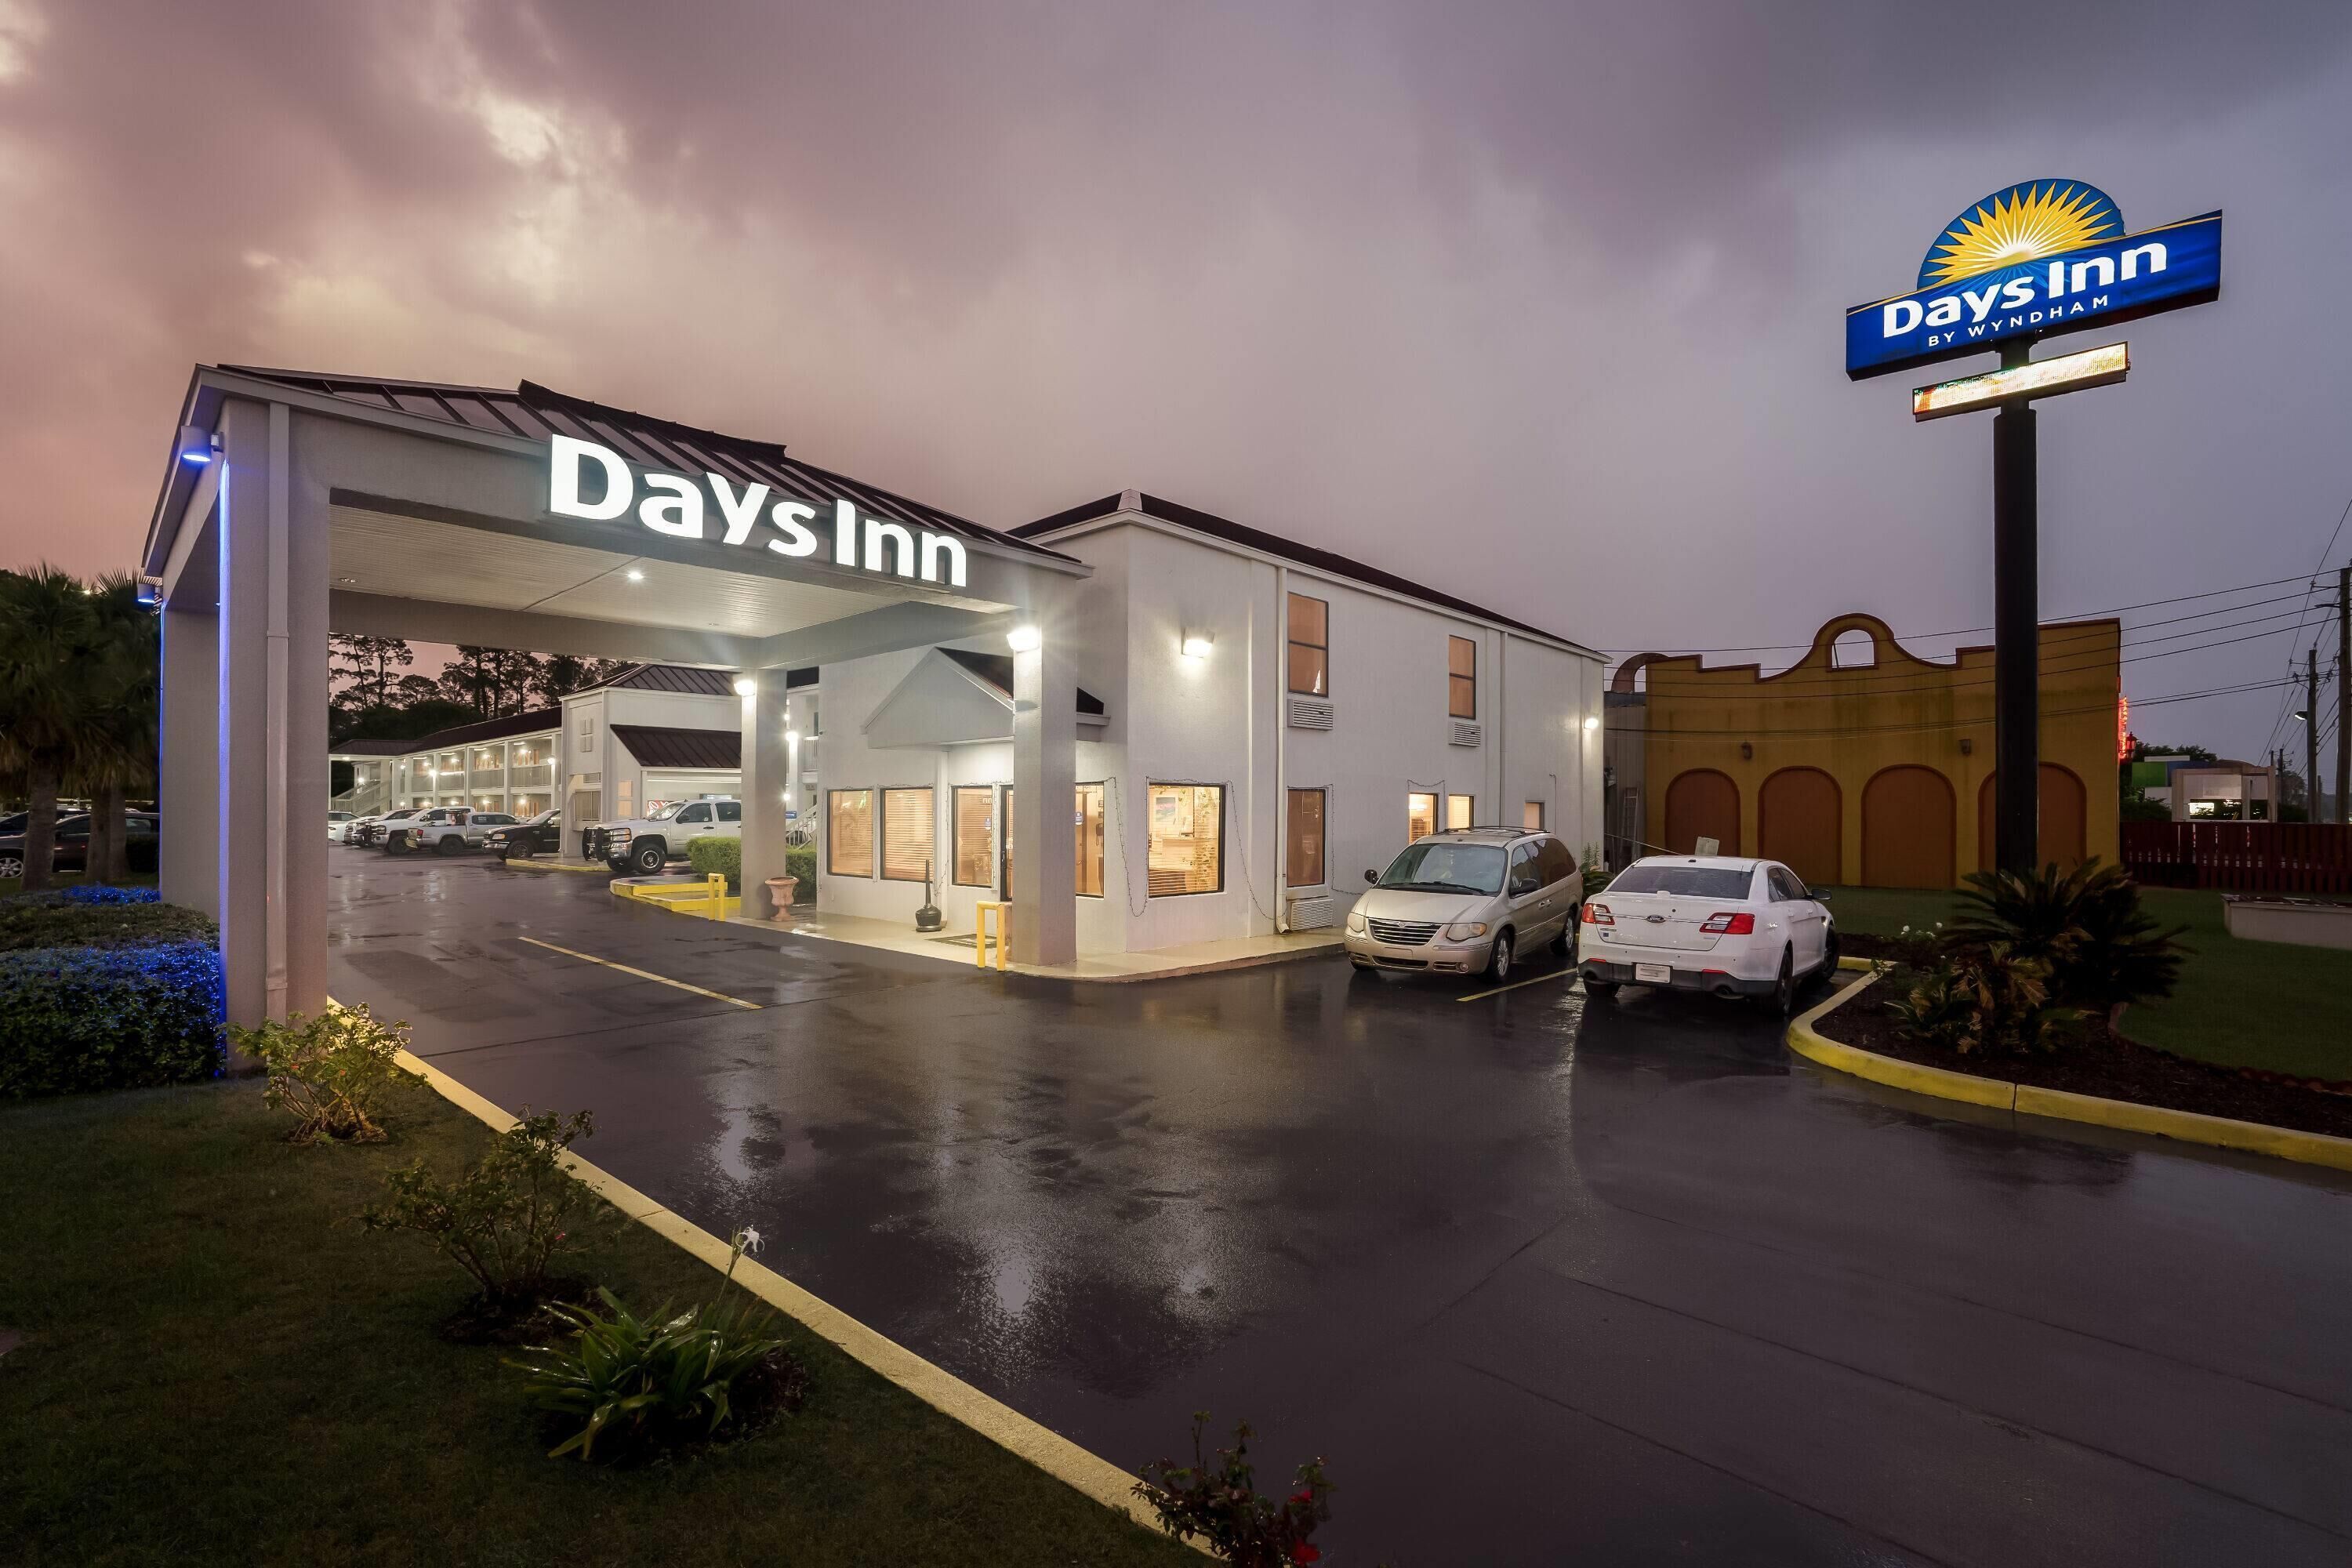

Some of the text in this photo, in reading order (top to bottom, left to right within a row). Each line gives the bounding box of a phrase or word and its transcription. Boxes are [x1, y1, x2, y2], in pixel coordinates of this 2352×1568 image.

[1883, 242, 2167, 338] Days Inn
[1929, 295, 2109, 347] BY WYNDHAM
[550, 434, 967, 587] Days Inn
